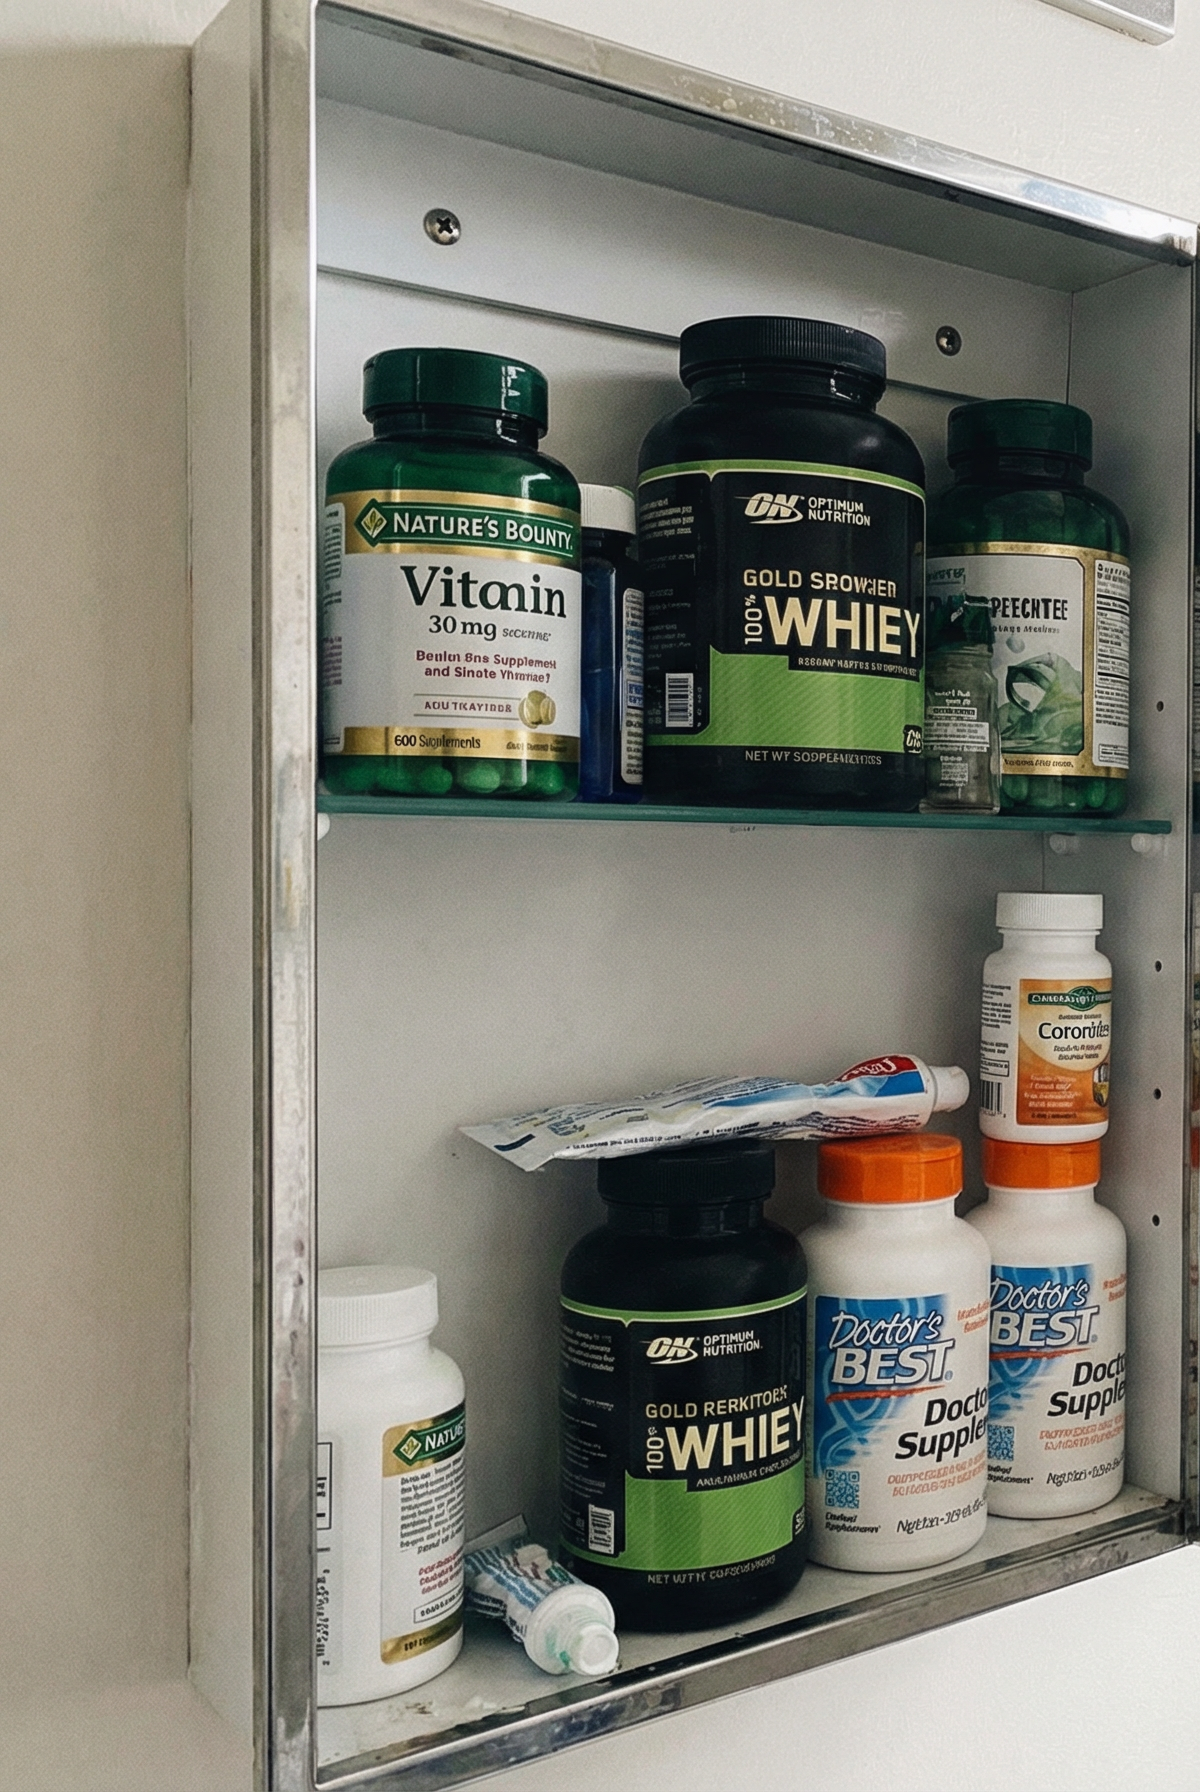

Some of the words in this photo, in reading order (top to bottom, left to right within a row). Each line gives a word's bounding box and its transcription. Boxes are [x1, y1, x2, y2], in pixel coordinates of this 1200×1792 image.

[808, 497, 864, 512] OPTIMUM
[808, 510, 871, 527] NUTRITION
[393, 512, 499, 538] NATURE'S
[505, 521, 573, 550] BOUNTY
[743, 569, 802, 588] GOLD
[429, 615, 457, 634] 30
[460, 620, 497, 641] mg
[744, 595, 762, 646] 100%
[425, 666, 450, 679] and
[394, 734, 417, 748] 600
[744, 750, 770, 762] NET
[989, 1276, 1090, 1312] Doctor's
[828, 1310, 944, 1350] Doctor's
[990, 1305, 1100, 1348] BEST
[703, 1330, 755, 1346] OPTIMUM
[830, 1337, 956, 1387] BEST
[645, 1402, 697, 1419] GOLD
